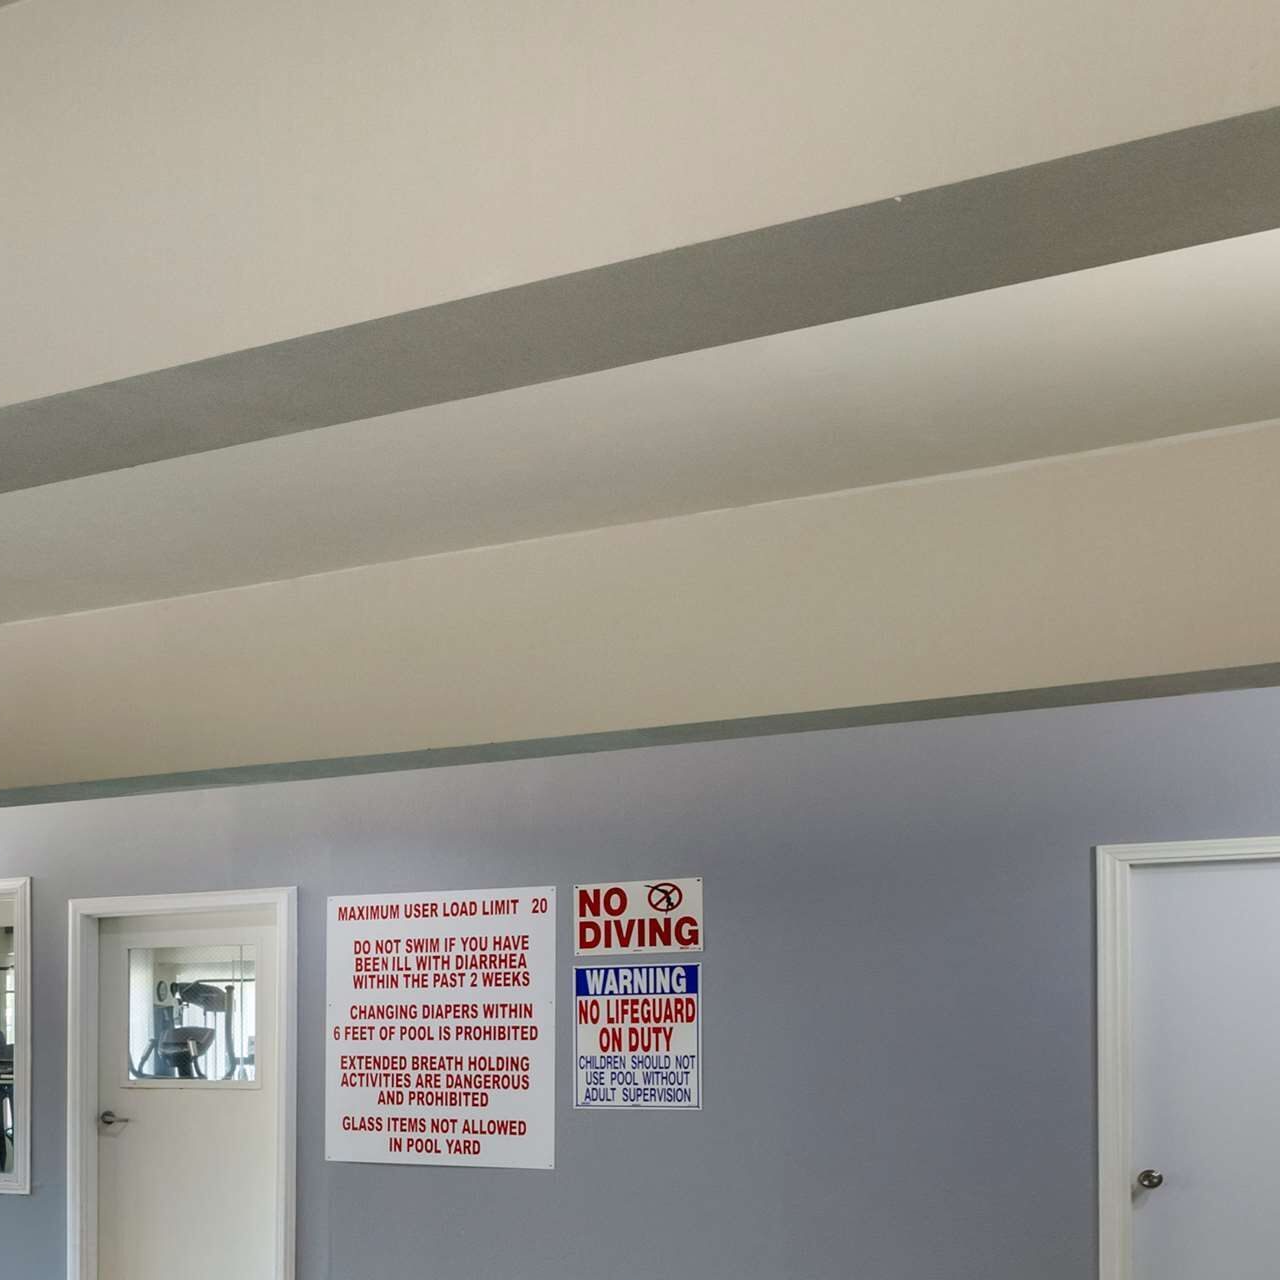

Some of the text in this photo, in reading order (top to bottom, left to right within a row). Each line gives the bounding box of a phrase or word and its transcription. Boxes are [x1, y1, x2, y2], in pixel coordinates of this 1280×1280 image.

[337, 897, 548, 921] MAXIMUM USER LOAD LIMIT 20
[579, 887, 627, 917] NO
[579, 916, 699, 949] DIVING
[354, 935, 529, 955] DO NOT SWIM IF YOU HAVE
[355, 953, 527, 972] BEEN ILL WITH DIARRHEA
[353, 971, 530, 990] WITHIN THE PAST 2 WEEKS
[586, 967, 686, 994] WARNING
[349, 1003, 534, 1021] CHANGING DIAPERS WITHIN
[579, 998, 696, 1024] NO LIFEGUARD
[333, 1024, 538, 1041] 6 FEET OF POOL IS PROHIBITED
[599, 1027, 673, 1052] ON DUTY
[340, 1056, 530, 1072] EXTENDED BREATH HOLDING
[579, 1056, 695, 1069] CHILDREN SHOULD NOT
[340, 1073, 529, 1090] ACTIVITIES ARE DANGEROUS
[586, 1072, 690, 1085] USE POOL WITHOUT
[377, 1091, 489, 1107] AND PROHIBITED
[584, 1088, 691, 1102] ADULT SUPERVISION
[342, 1116, 527, 1136] GLASS ITEMS NOT ALLOWED
[390, 1136, 480, 1156] IN POOL YARD
